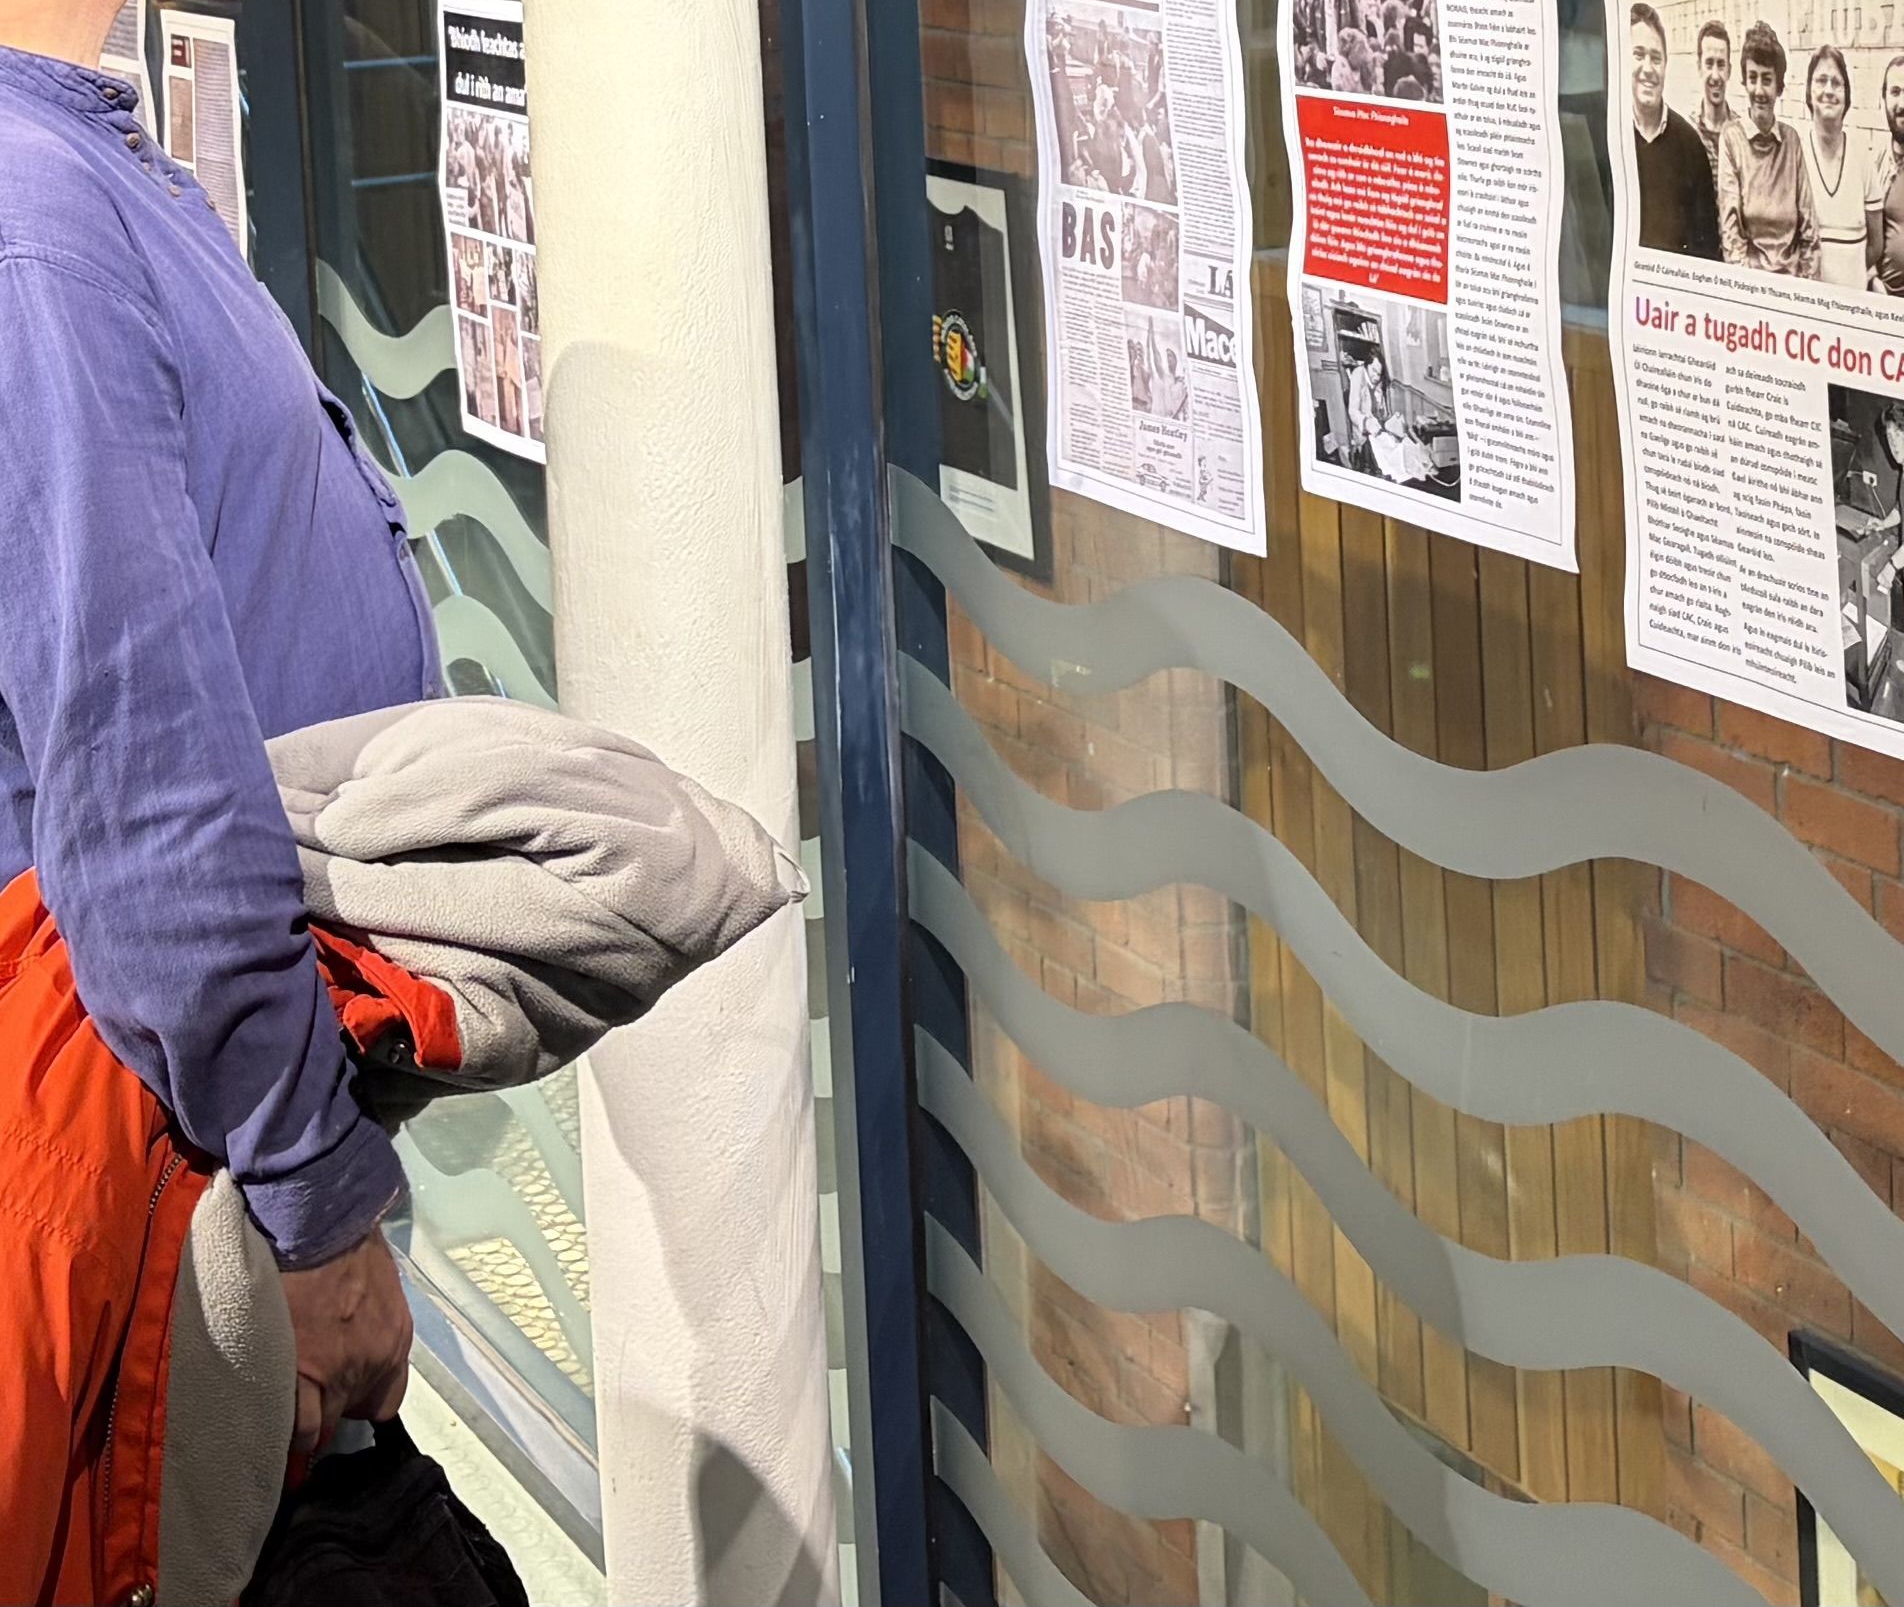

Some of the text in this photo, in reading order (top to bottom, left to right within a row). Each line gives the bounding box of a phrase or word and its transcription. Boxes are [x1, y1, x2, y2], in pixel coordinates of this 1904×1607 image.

[1060, 202, 1116, 271] BAS
[1635, 295, 1679, 332] Uair
[1684, 313, 1696, 336] a
[1703, 312, 1776, 355] tugadh
[1784, 328, 1820, 364] CIC
[1827, 336, 1872, 376] don
